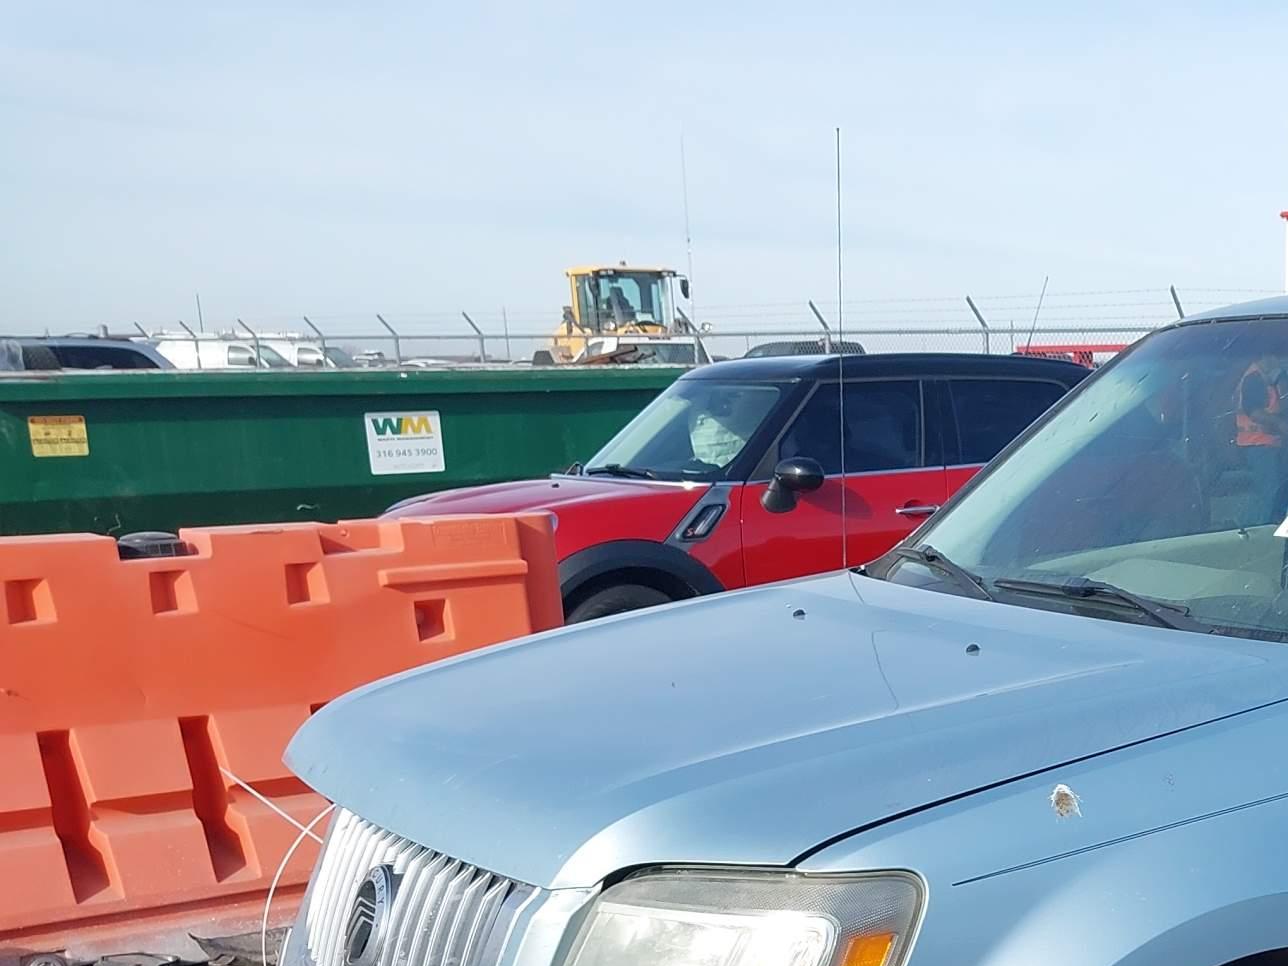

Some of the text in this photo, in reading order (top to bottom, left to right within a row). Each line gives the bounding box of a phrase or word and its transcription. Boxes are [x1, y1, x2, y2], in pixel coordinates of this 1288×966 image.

[371, 416, 433, 436] WM
[395, 449, 412, 457] 945
[415, 448, 438, 456] 3900
